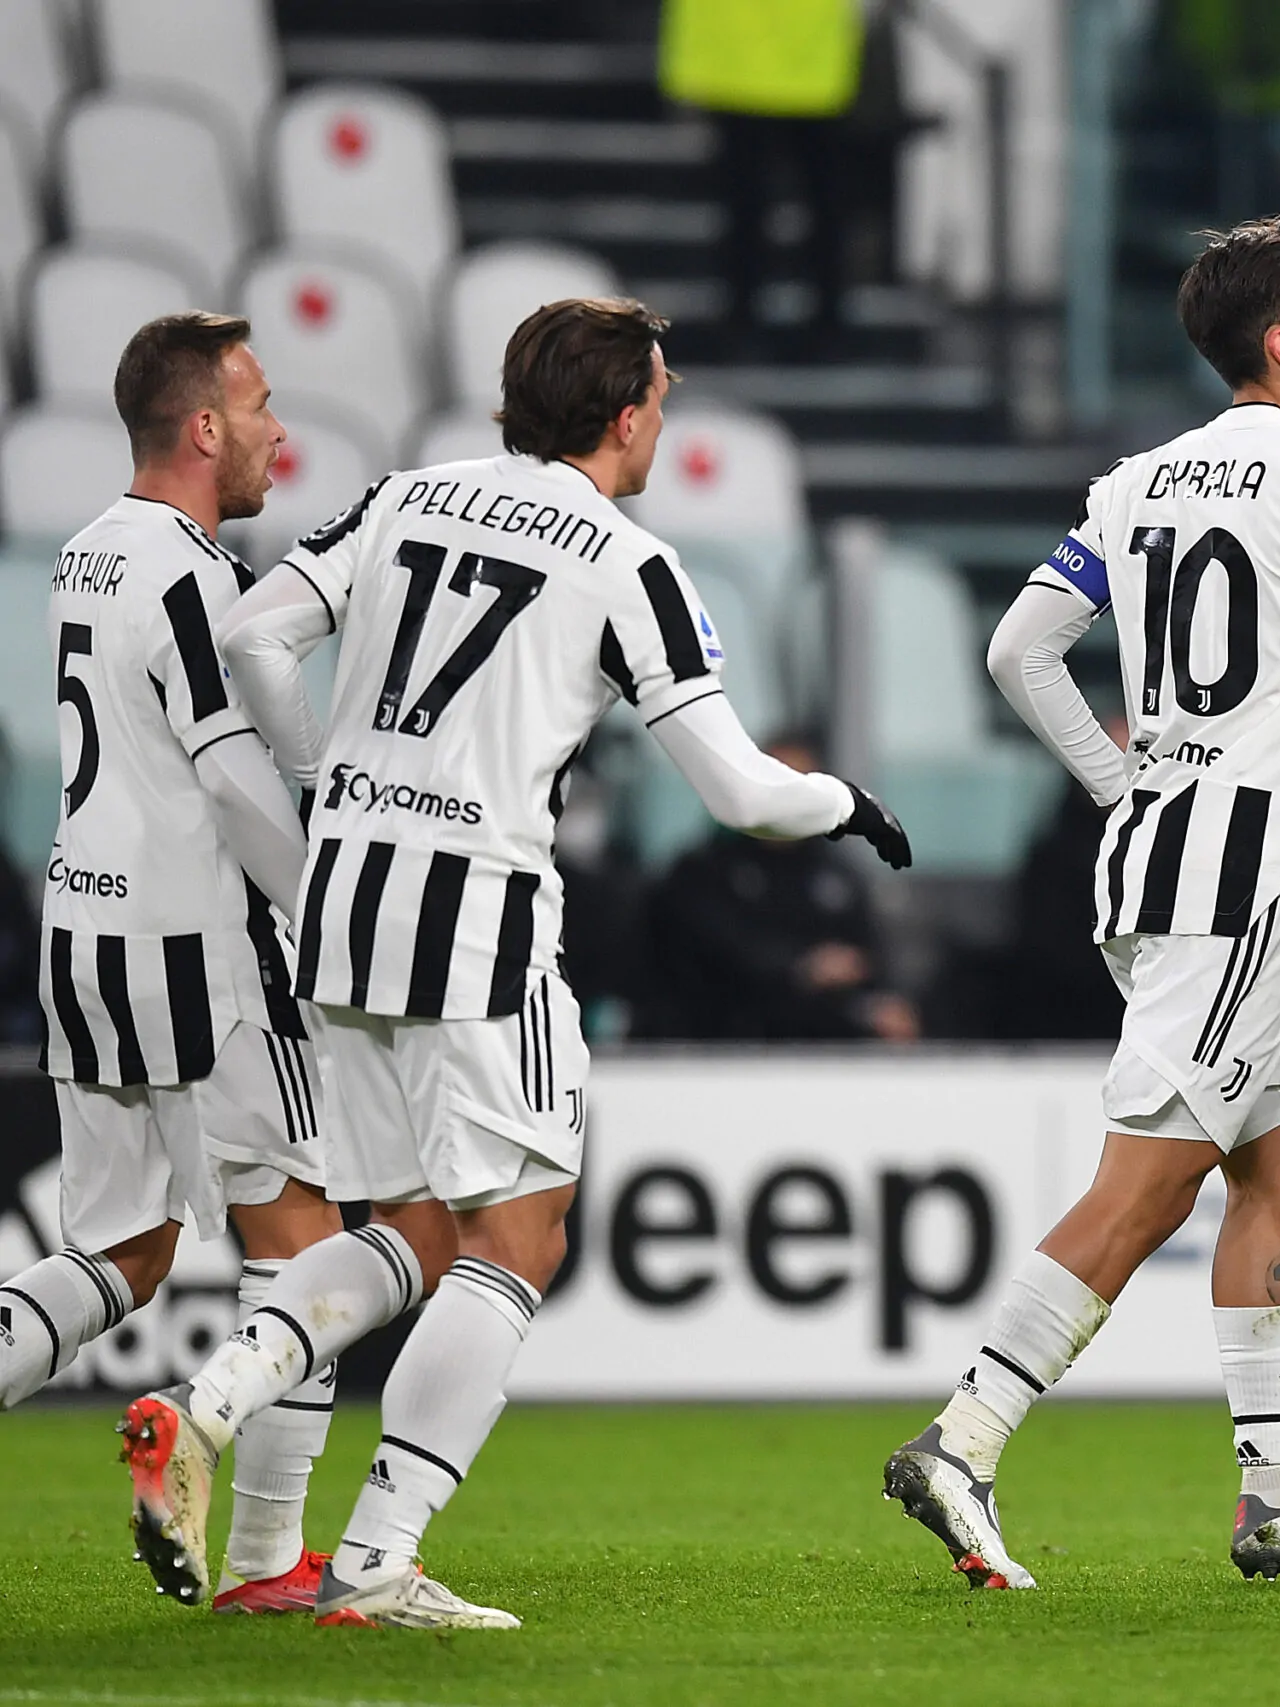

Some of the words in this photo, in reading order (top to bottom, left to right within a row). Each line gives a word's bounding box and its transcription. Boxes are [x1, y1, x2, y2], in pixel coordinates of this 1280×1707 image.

[397, 480, 613, 563] PELLEGRINI
[1145, 458, 1267, 500] DYBALA
[371, 538, 548, 739] 17
[1128, 525, 1259, 718] 10
[56, 620, 100, 821] 5
[347, 772, 484, 826] Cygames
[542, 1158, 1000, 1355] eep
